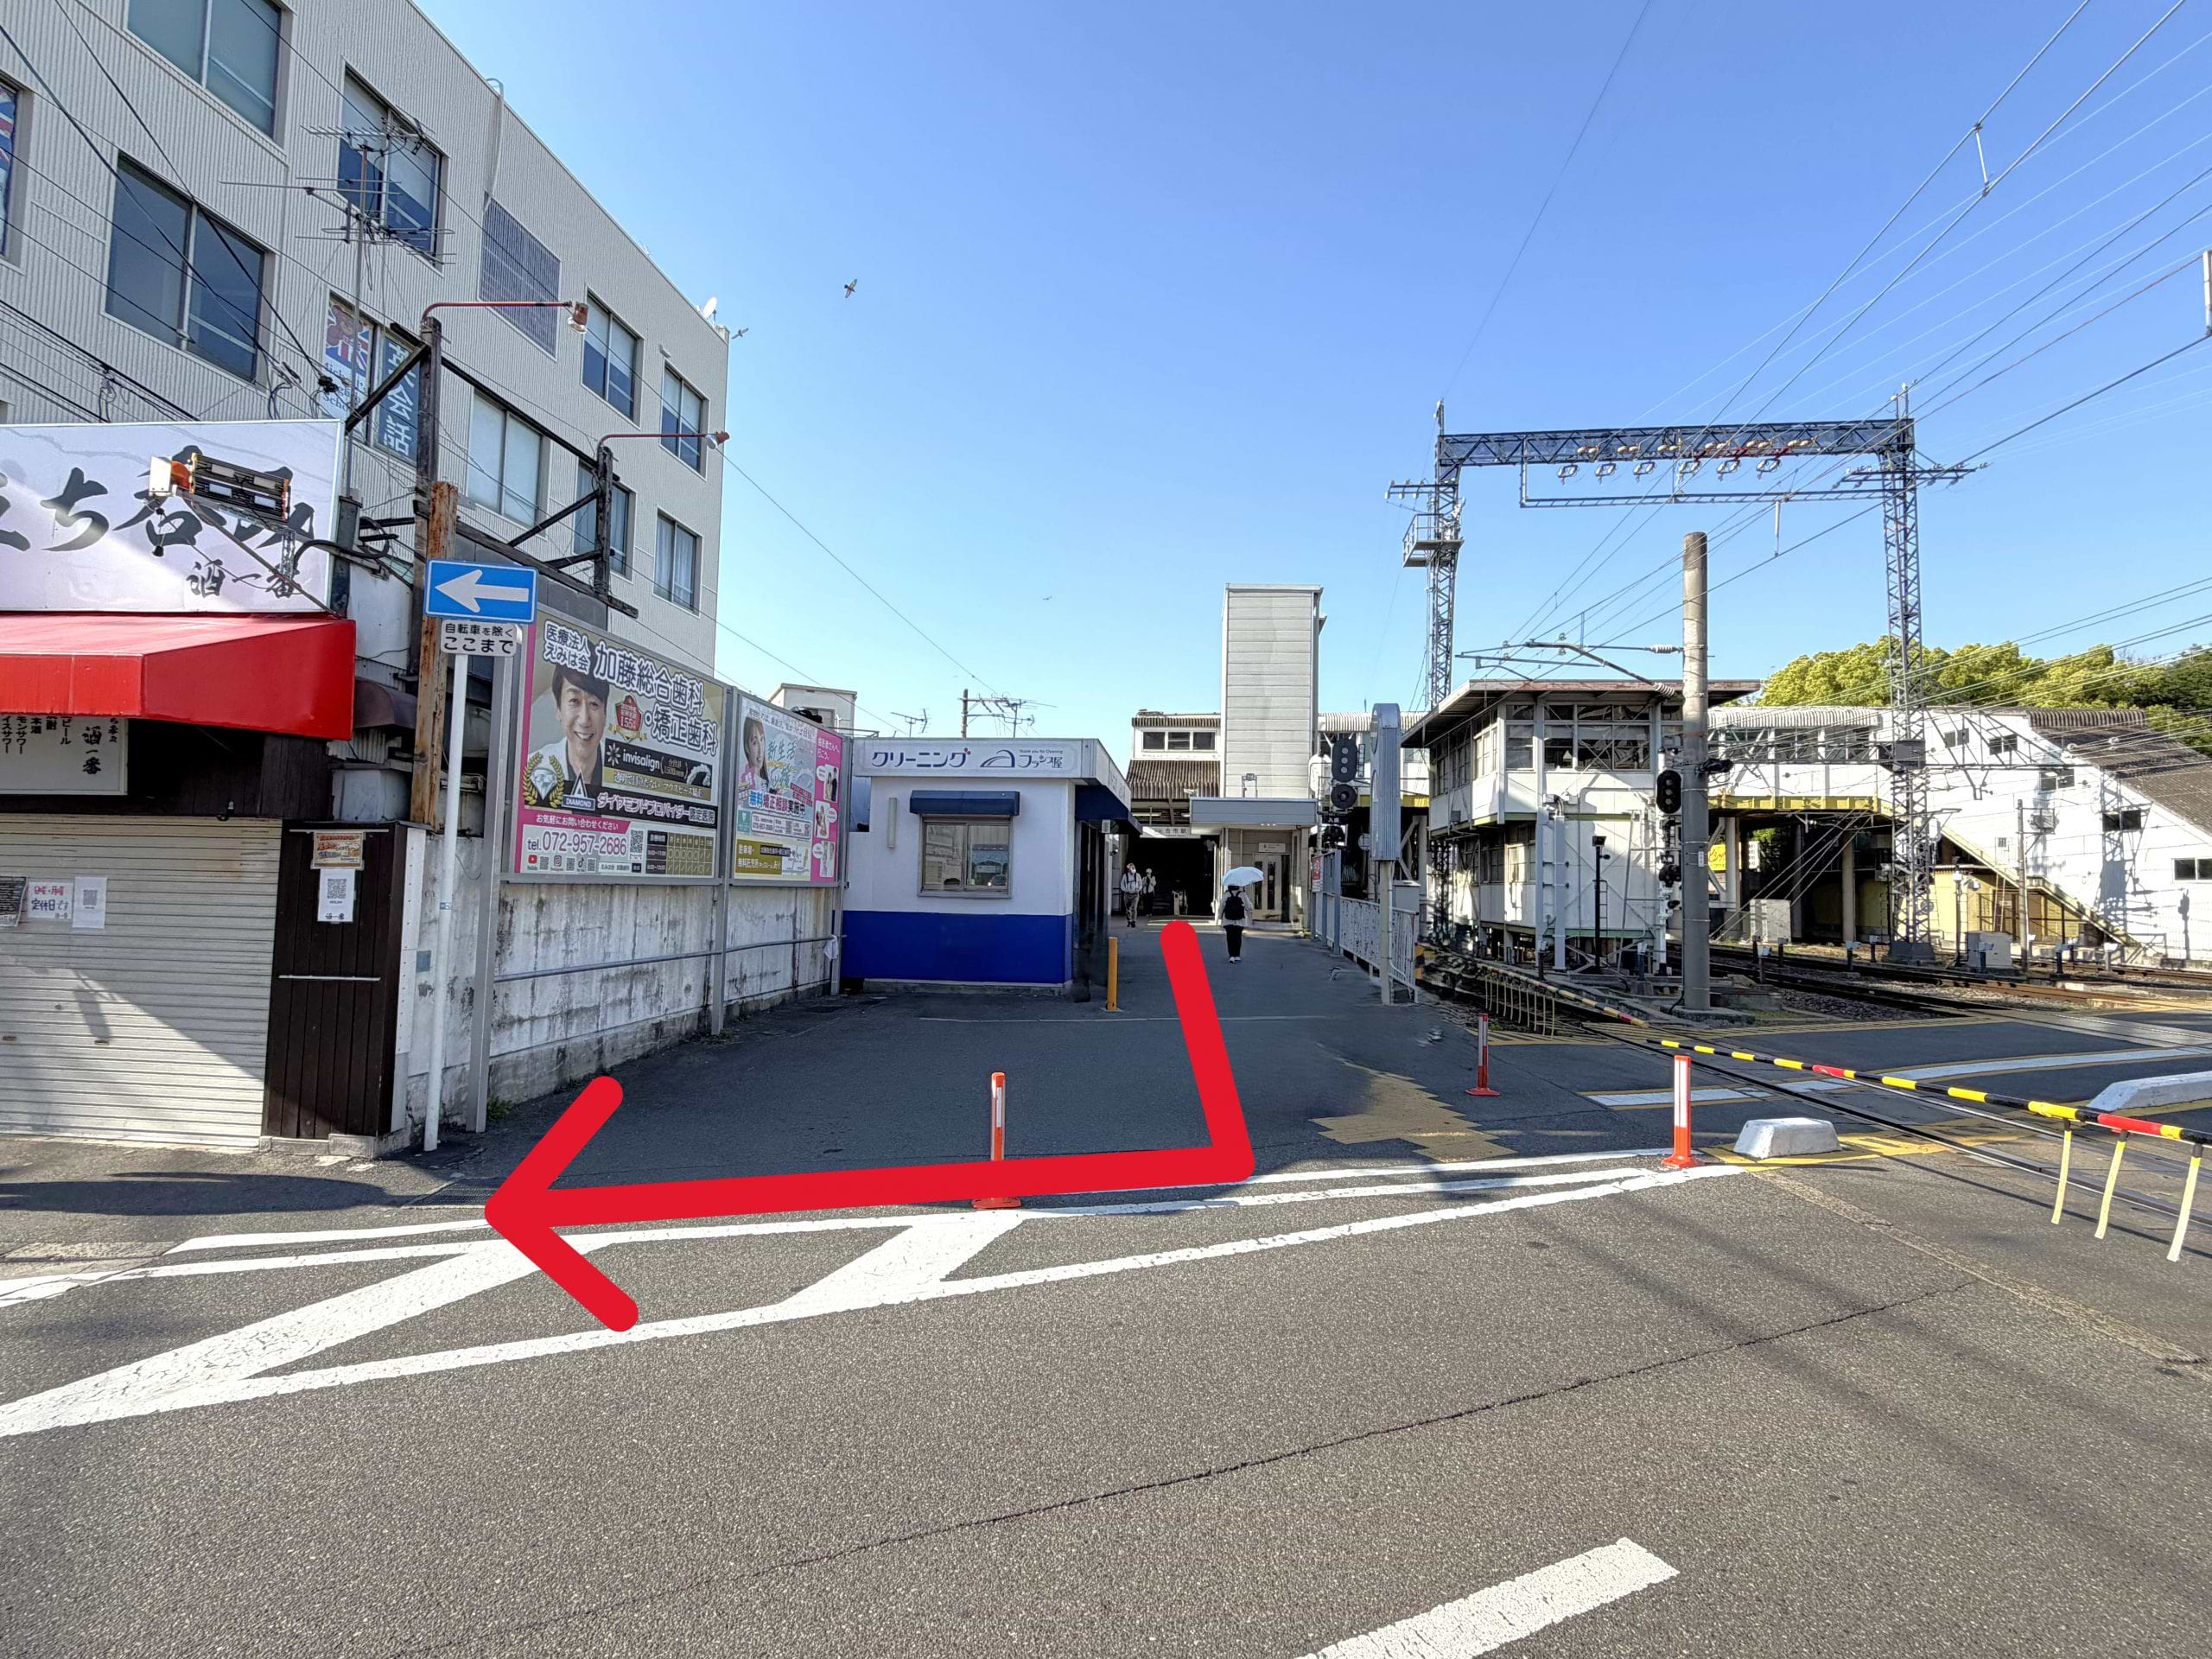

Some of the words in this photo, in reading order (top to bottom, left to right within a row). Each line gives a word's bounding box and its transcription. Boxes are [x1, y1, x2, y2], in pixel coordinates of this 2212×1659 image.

[445, 623, 513, 638] 自転車を除く
[546, 621, 591, 657] 医療法人
[444, 637, 514, 654] ここまで
[543, 641, 590, 674] えみは会
[594, 641, 704, 715] 加藤総合歯科
[46, 715, 57, 730] 酎
[60, 715, 73, 745] ビール
[82, 725, 102, 775] 酒一番
[622, 749, 660, 771] invisalign
[871, 747, 971, 768] クリーニング
[566, 798, 592, 808] DIAMOND
[536, 814, 619, 830] お気軽にお問い合わせください
[31, 898, 69, 912] 定休日です
